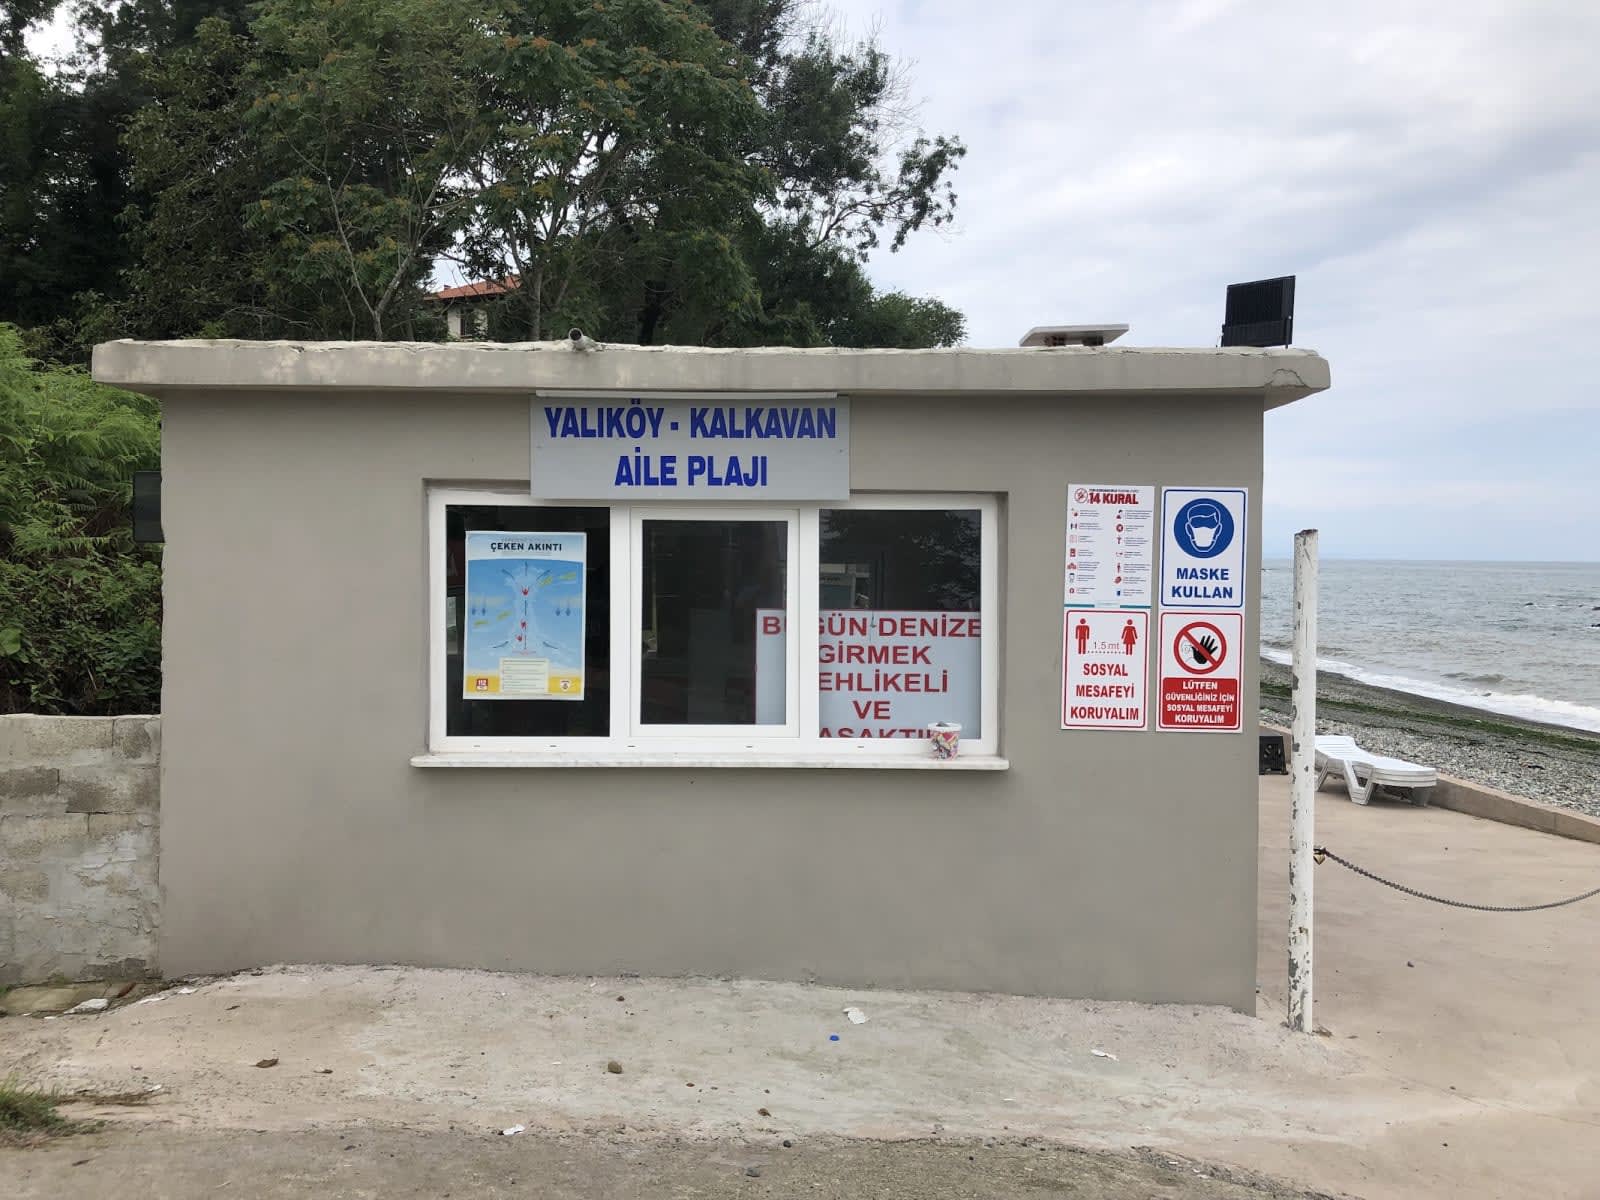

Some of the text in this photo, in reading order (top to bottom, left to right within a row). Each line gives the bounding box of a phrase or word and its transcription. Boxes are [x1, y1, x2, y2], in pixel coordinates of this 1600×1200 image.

[544, 398, 664, 439] YALIKÖY
[690, 407, 836, 439] KALKAVAN
[614, 446, 767, 487] AİLE PLAJI
[1089, 492, 1139, 505] 14 KURAL
[490, 542, 562, 552] ÇEKEN AKINTI
[1176, 567, 1229, 580] MASKE
[1171, 586, 1233, 598] KULLAN
[879, 614, 981, 638] DENİZE
[819, 640, 932, 665] GİRMEK
[1083, 663, 1128, 677] SOSYAL
[819, 669, 948, 693] EHLİKELİ
[1183, 680, 1218, 690] LÜTFEN
[1076, 683, 1135, 698] MESAFEYİ
[1165, 692, 1235, 704] GÜVENLİĞİNİZ İÇİN
[852, 700, 891, 720] VE
[1070, 706, 1139, 721] KORUYALIM
[1167, 703, 1233, 713] SOSYAL MESAFEYİ
[1175, 714, 1224, 723] KORUYALIM
